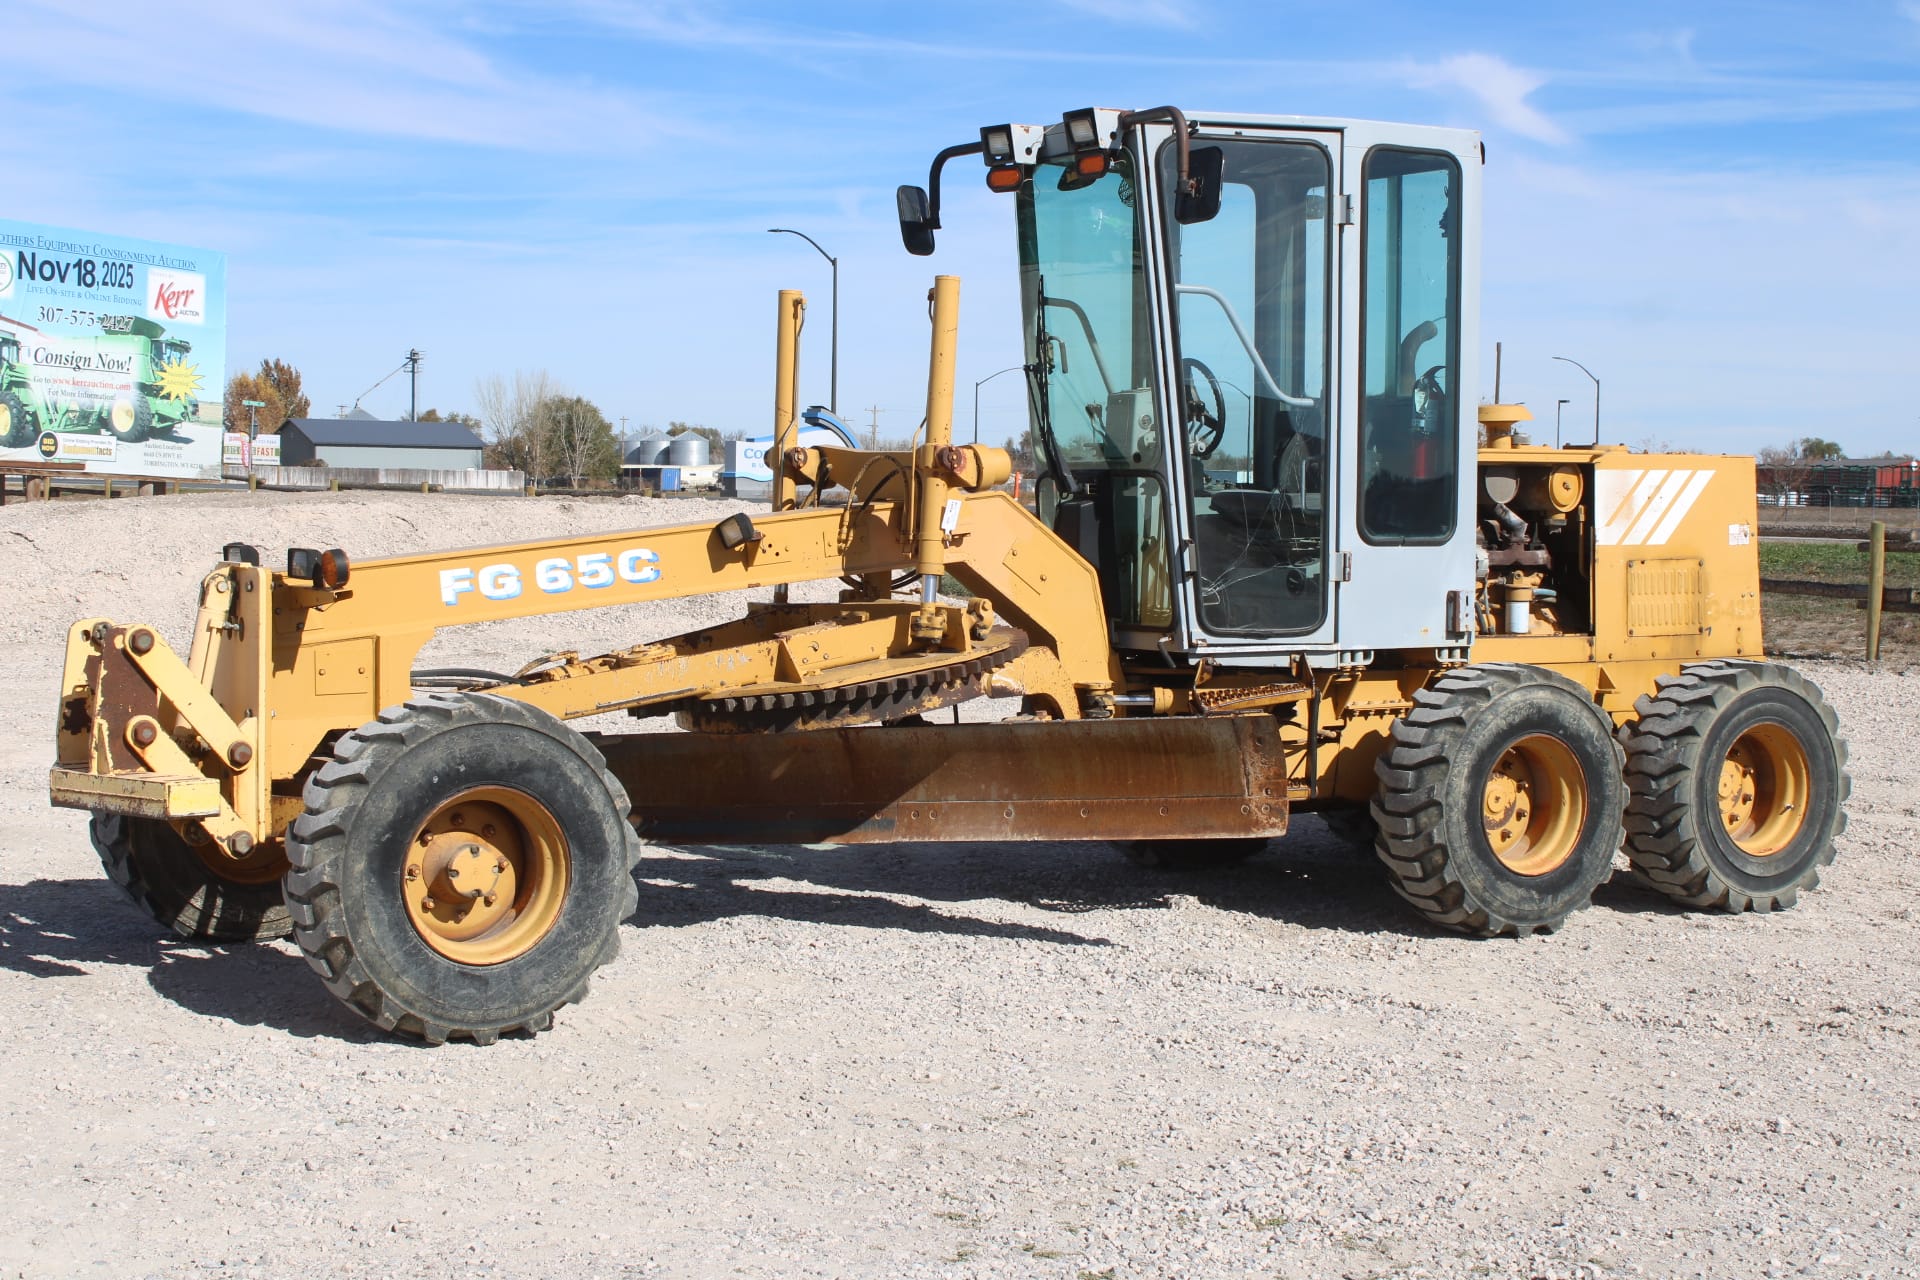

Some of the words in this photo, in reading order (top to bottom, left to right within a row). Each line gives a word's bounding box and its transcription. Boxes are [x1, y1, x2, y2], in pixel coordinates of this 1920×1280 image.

[37, 235, 91, 254] EQUIPMENT
[93, 243, 157, 265] CONSIGNMENT
[158, 254, 197, 270] AUCTION
[154, 281, 195, 319] Kerr
[179, 309, 200, 317] AUCTION
[37, 305, 136, 332] 307-575-2427
[33, 346, 92, 373] Consign
[95, 352, 132, 373] Now!
[256, 447, 274, 457] FAST
[743, 447, 767, 460] Co
[439, 563, 522, 606] FG
[535, 548, 661, 593] 65C
